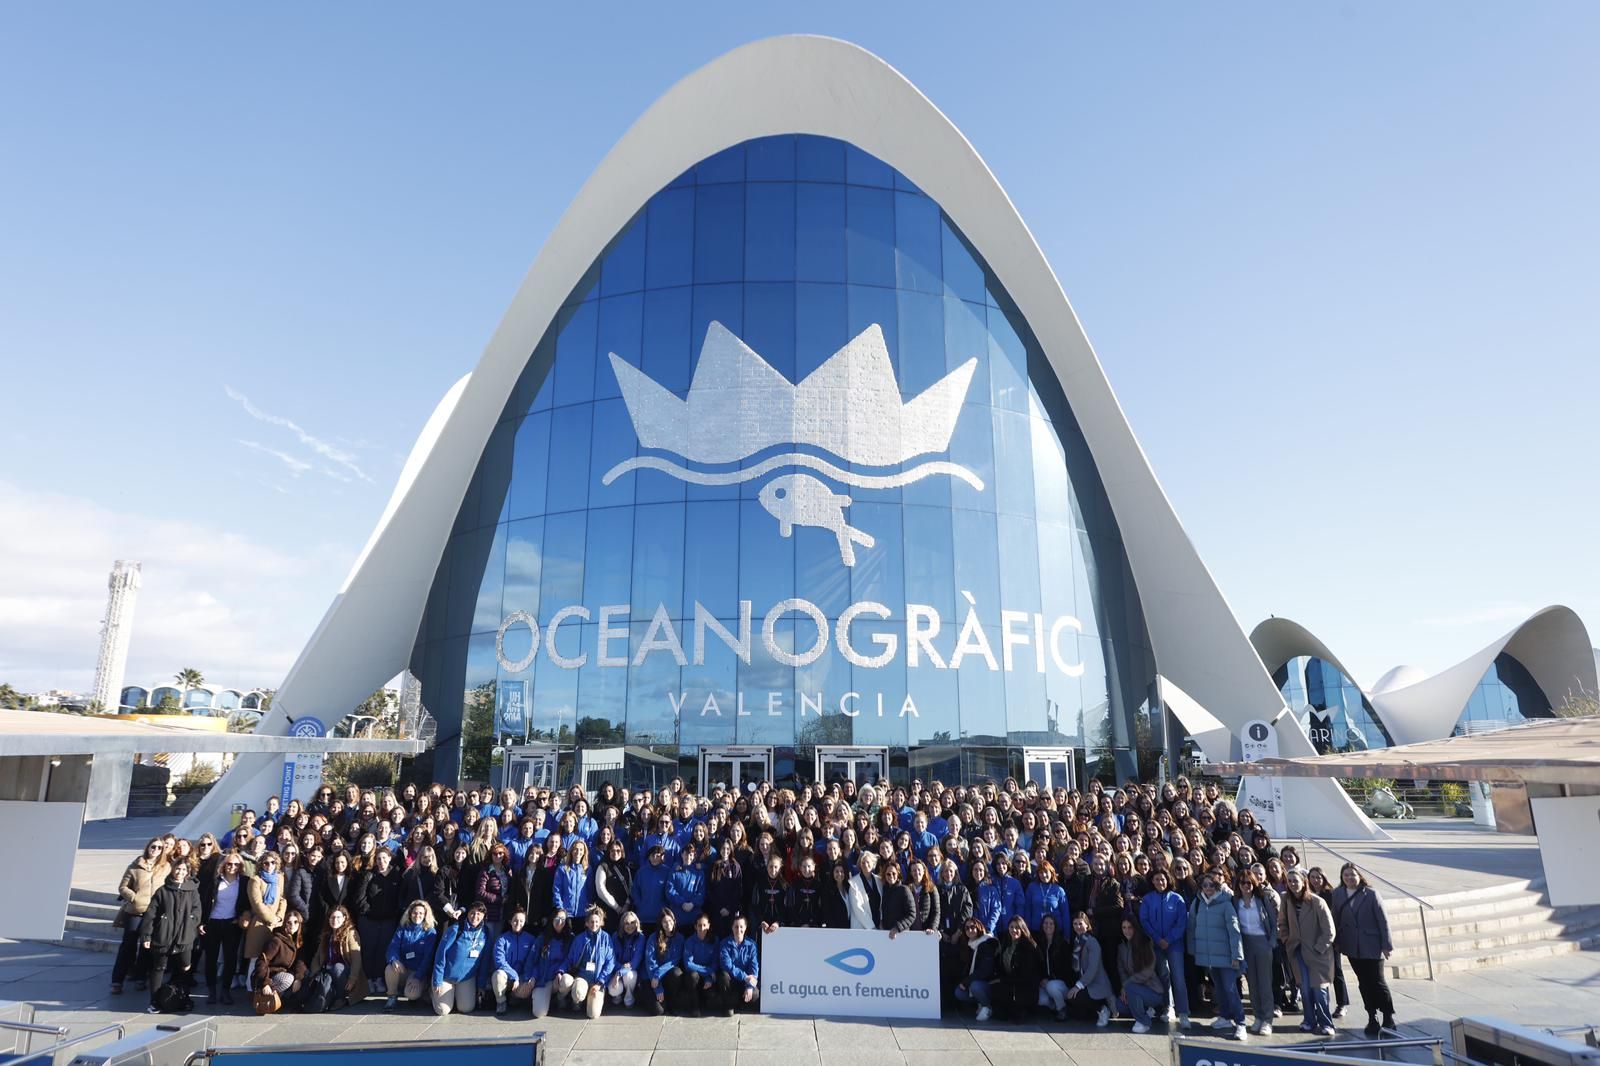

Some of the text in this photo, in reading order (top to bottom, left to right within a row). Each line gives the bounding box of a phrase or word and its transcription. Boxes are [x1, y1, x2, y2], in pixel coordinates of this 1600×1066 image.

[495, 591, 1085, 677] OCEANOGRÀFIC
[668, 692, 919, 718] VALENCIA
[1306, 727, 1361, 743] ARINO
[284, 764, 292, 785] POINT
[770, 981, 930, 999] el agua en femenino
